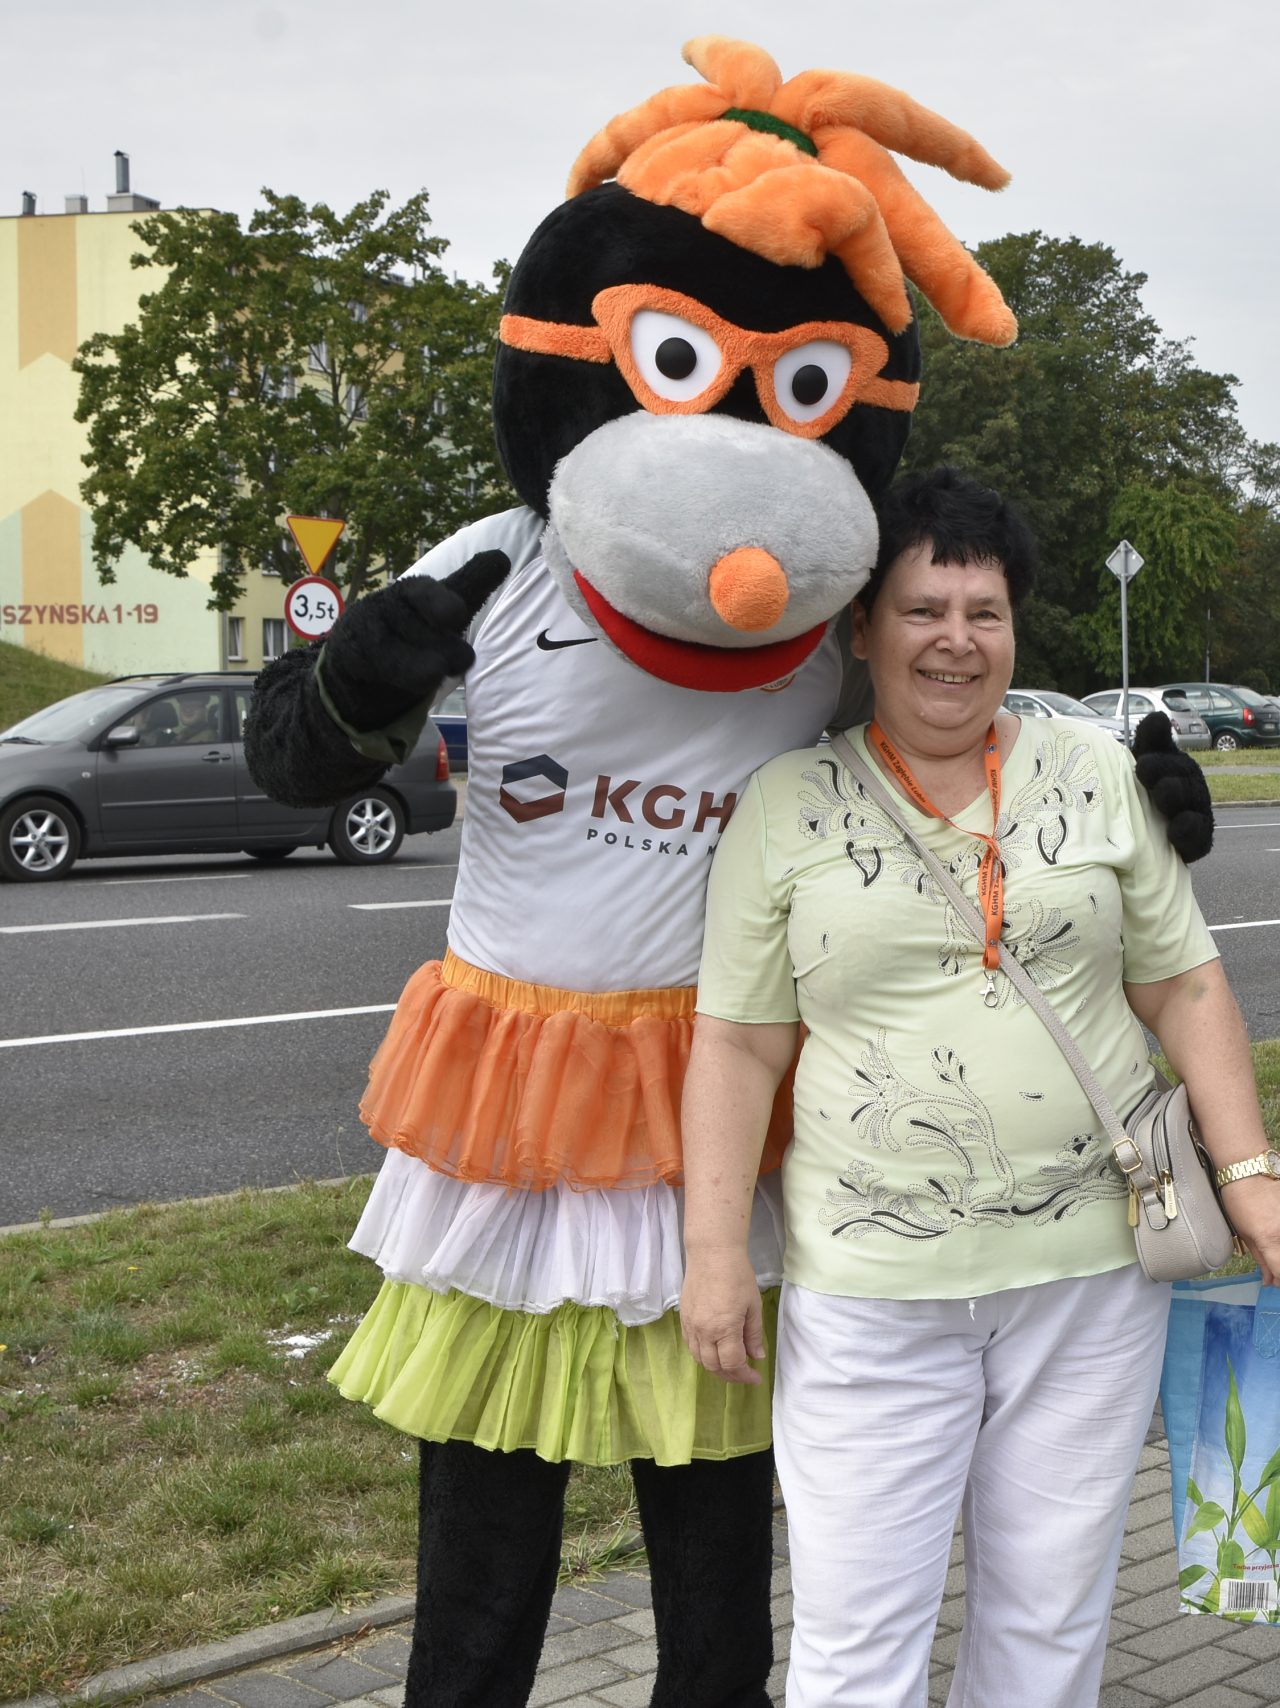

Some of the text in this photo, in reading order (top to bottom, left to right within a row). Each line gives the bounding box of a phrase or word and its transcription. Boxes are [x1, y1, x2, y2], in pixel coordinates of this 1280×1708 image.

[0, 602, 159, 625] SZYŃSKA 1-19
[294, 594, 335, 621] 3,5t
[591, 774, 737, 834] KGH
[586, 828, 688, 856] POLSKA
[991, 891, 999, 916] KGHM
